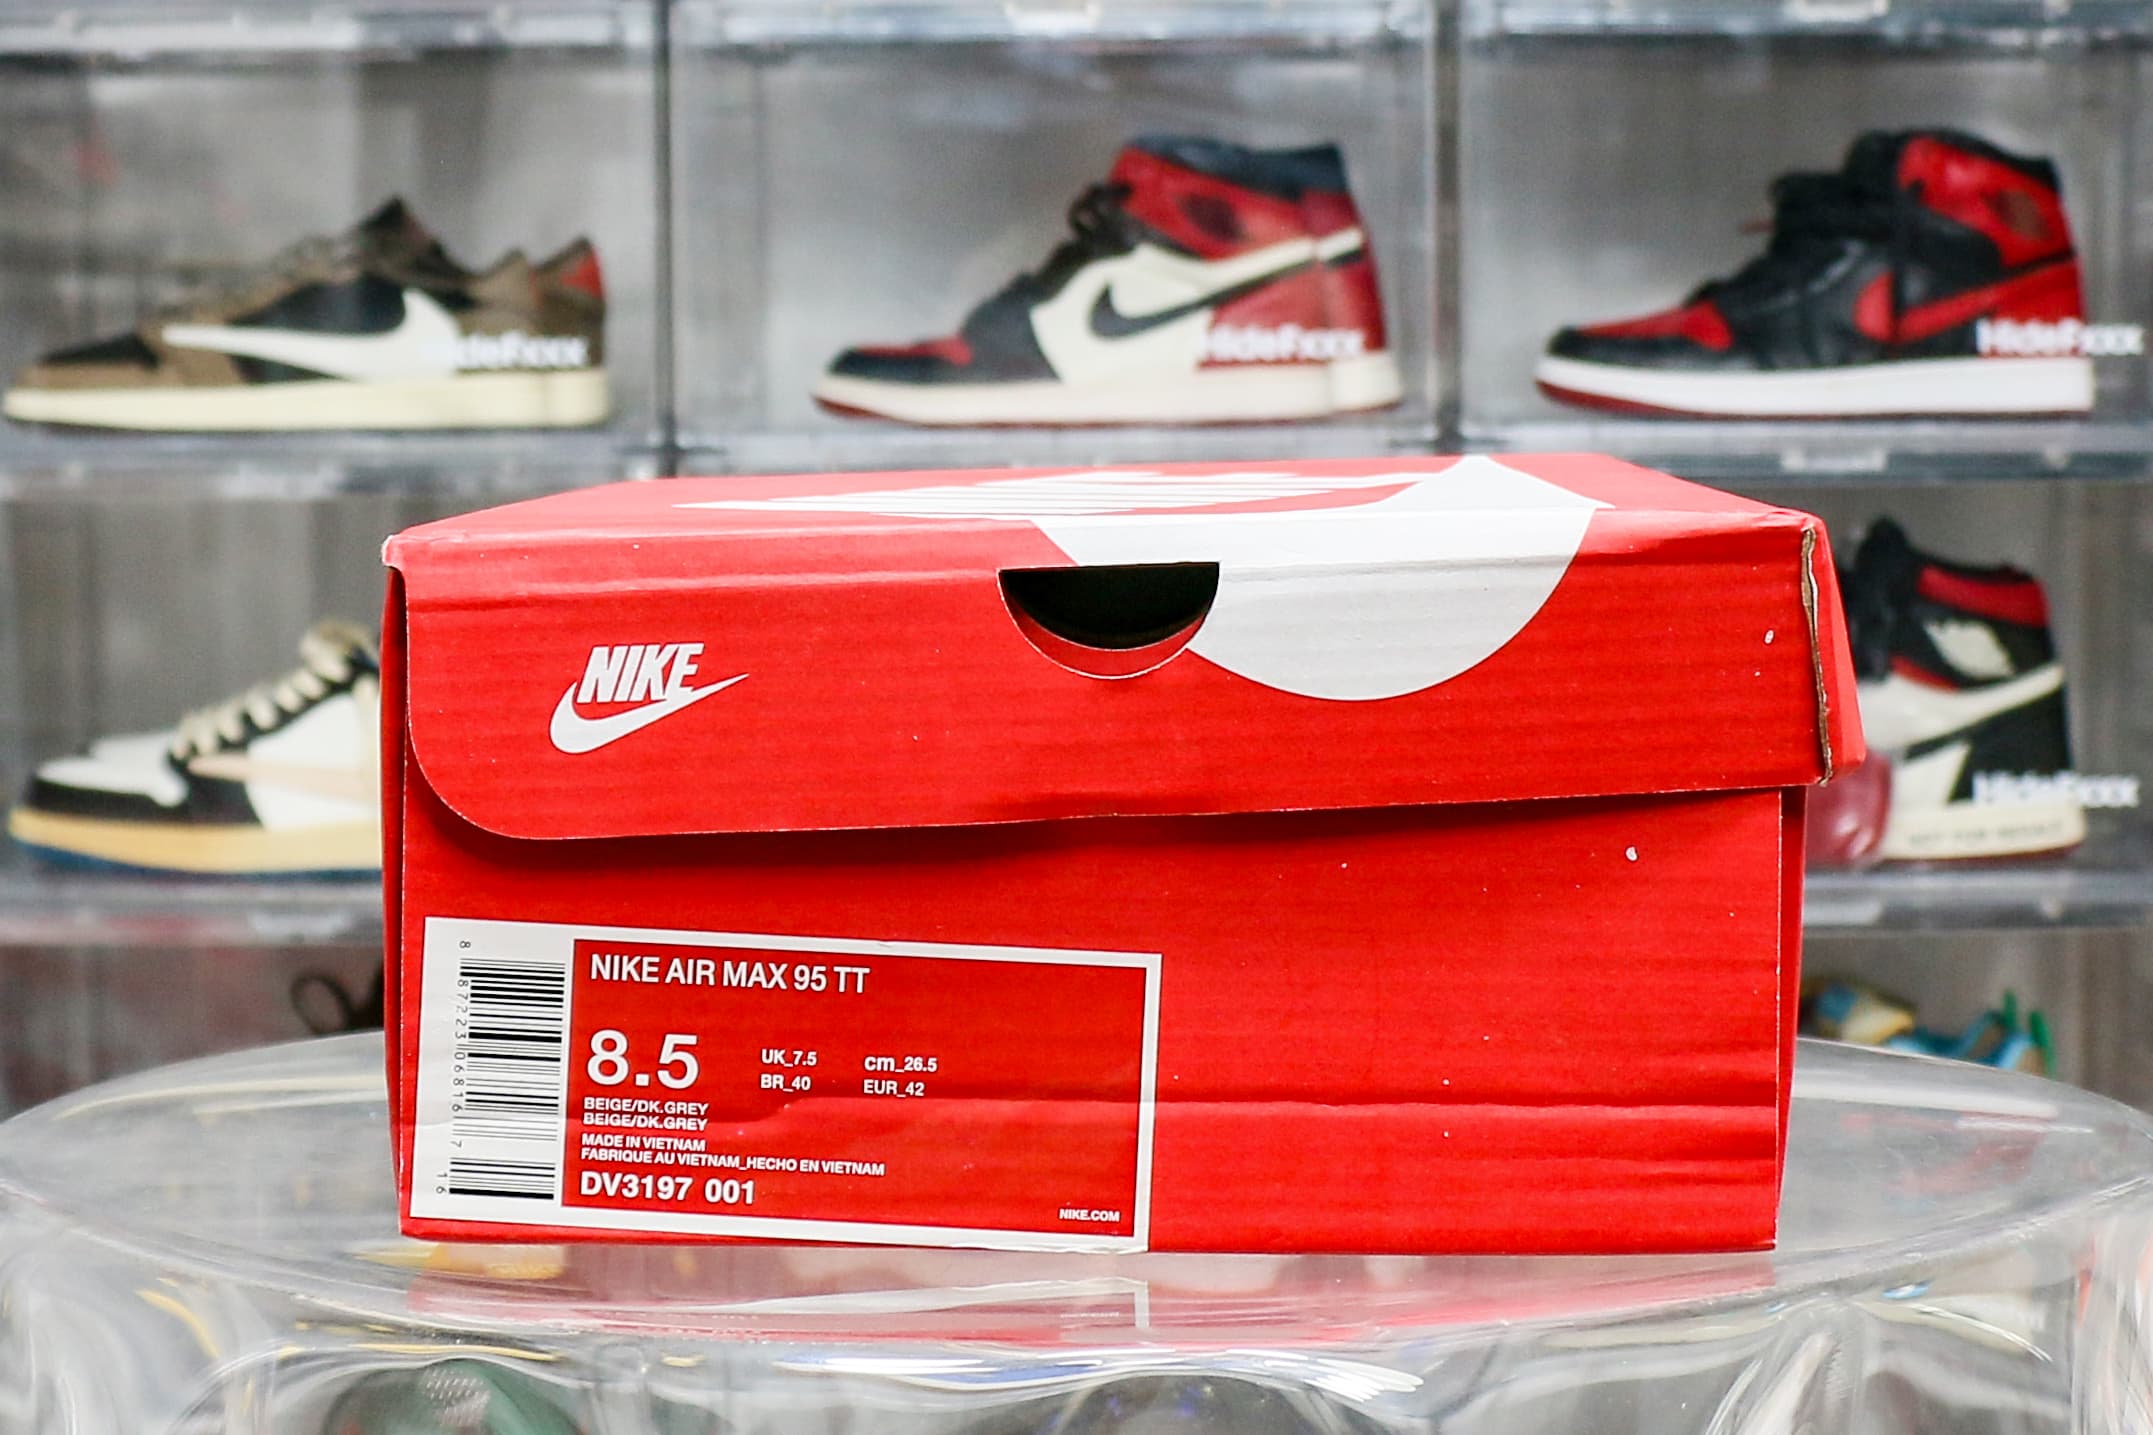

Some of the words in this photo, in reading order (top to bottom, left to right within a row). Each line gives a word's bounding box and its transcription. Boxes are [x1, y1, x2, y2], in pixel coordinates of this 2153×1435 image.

[577, 643, 705, 703] NIKE
[591, 954, 660, 983] NIKE
[665, 958, 716, 985] AIR
[722, 961, 787, 989] MAX
[793, 965, 828, 991] 95
[834, 966, 871, 993] TT
[587, 1029, 700, 1089] 8.5
[761, 1049, 818, 1067] UK_7.5
[864, 1056, 938, 1072] cm_26.5
[760, 1074, 812, 1092] BR_40
[863, 1079, 926, 1097] EUR_42
[583, 1097, 709, 1115] BEIGE/DK.GREY
[583, 1113, 708, 1131] BEIGE/DK.GREY
[581, 1133, 622, 1147] MADE
[626, 1135, 640, 1148] IN
[643, 1136, 706, 1151] VIETNAM
[581, 1148, 652, 1164] FABRIQUE
[654, 1151, 675, 1165] AU
[800, 1158, 819, 1173] EN
[821, 1160, 885, 1176] VIETNAM
[580, 1171, 693, 1201] DV3197
[704, 1179, 755, 1204] 001
[1059, 1208, 1120, 1222] NIKE.COM
